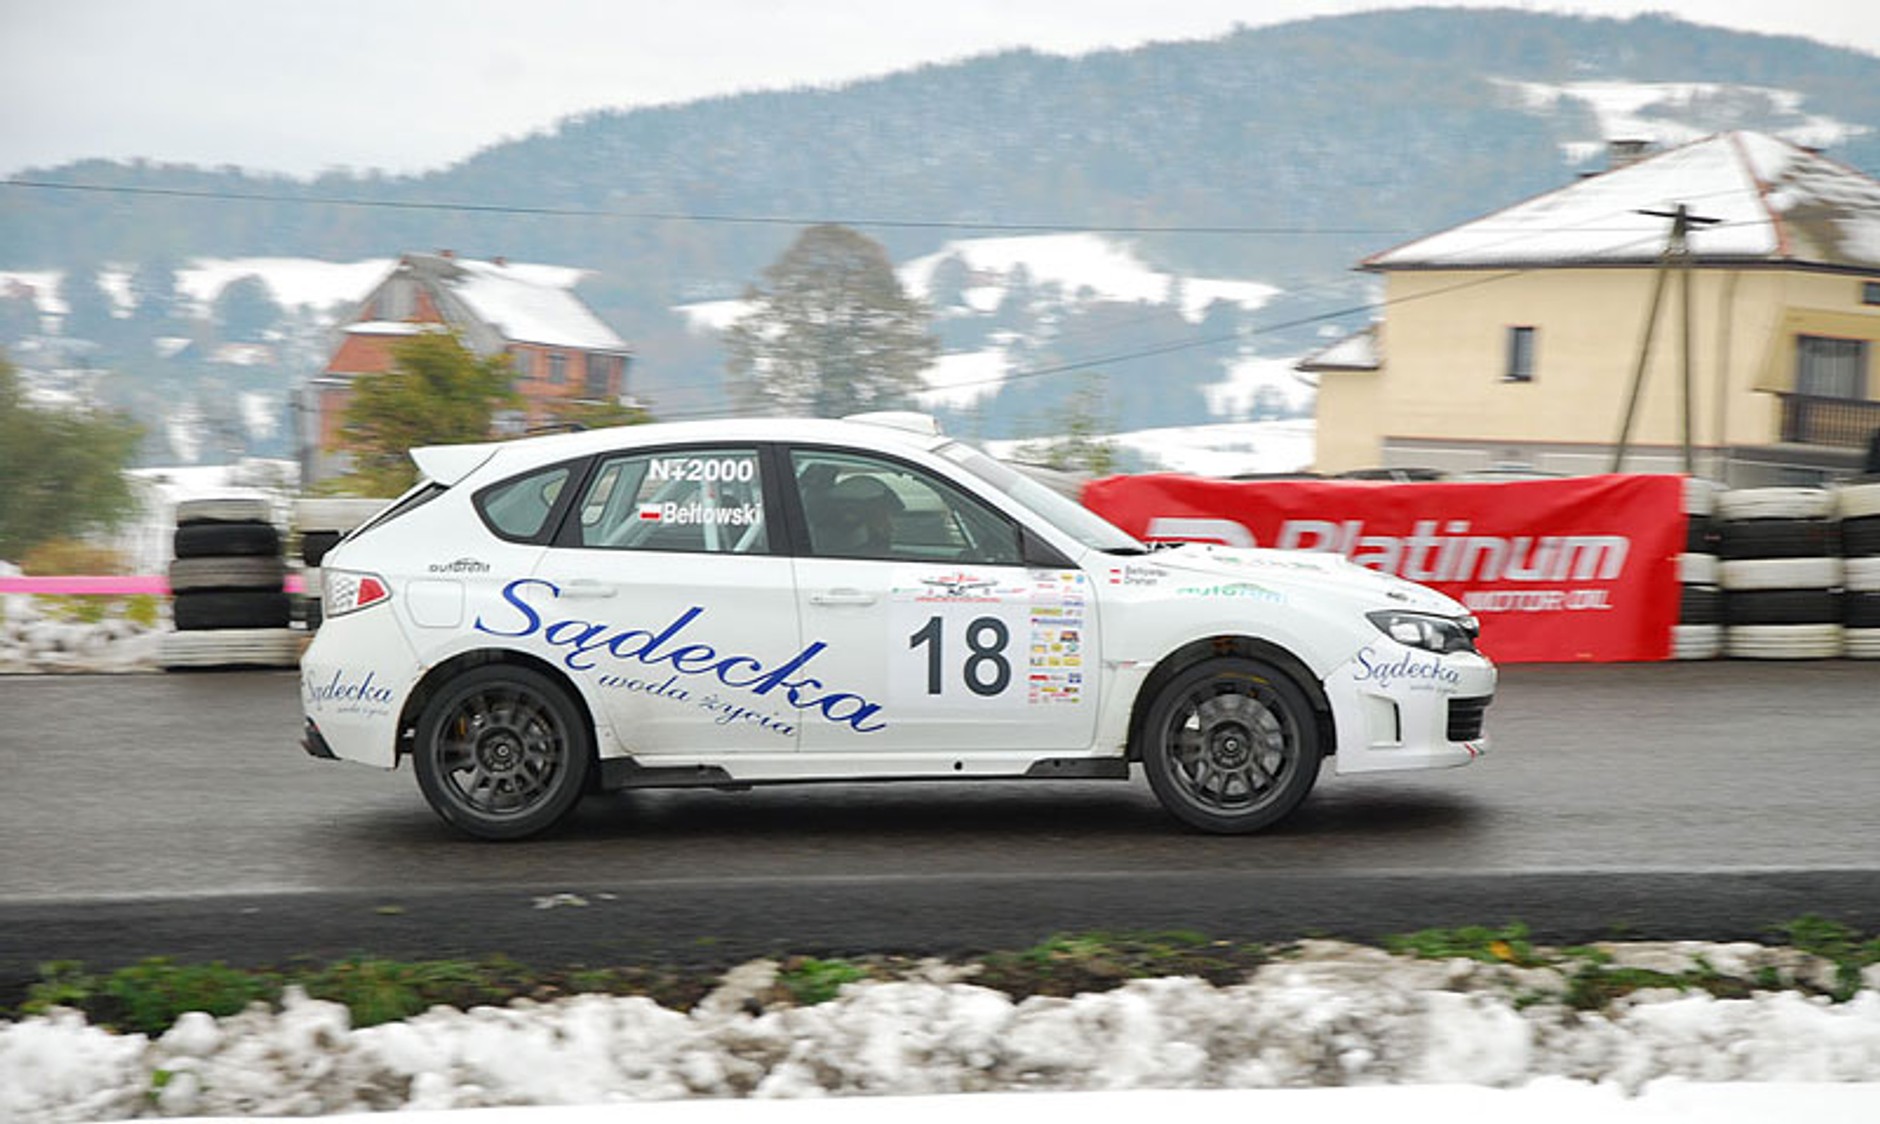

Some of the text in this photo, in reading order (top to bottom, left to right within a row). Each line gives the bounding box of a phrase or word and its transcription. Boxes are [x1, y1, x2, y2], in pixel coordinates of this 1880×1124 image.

[649, 458, 754, 481] N+2000
[1274, 519, 1630, 582] Platinum
[1463, 590, 1614, 612] MOTOR OIL
[474, 578, 887, 733] Sądecka
[909, 615, 1012, 697] 18
[1353, 646, 1459, 688] Sądecka
[599, 675, 796, 737] woda życia
